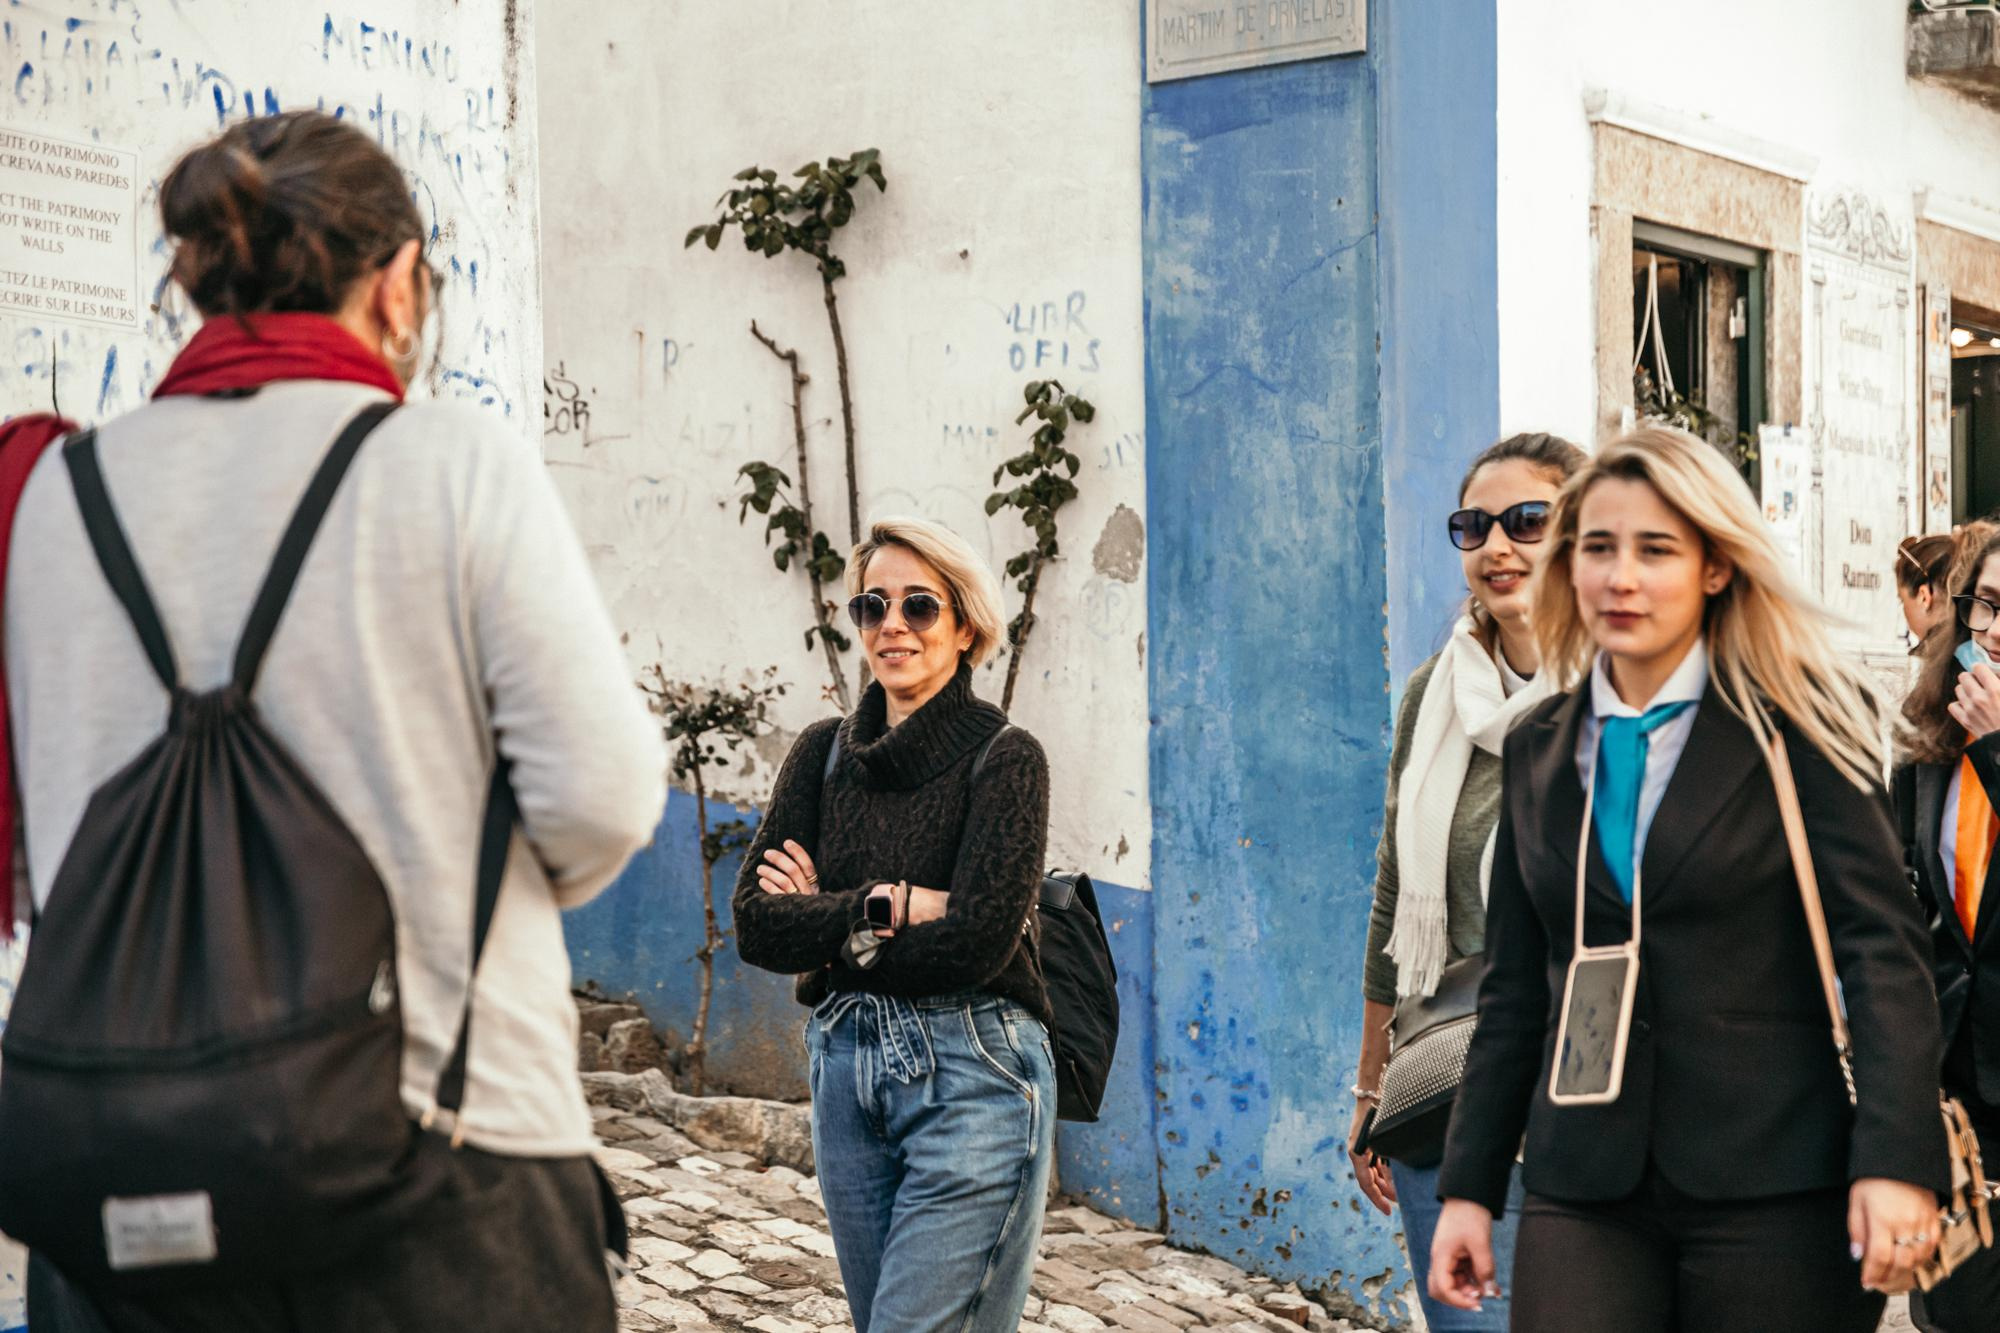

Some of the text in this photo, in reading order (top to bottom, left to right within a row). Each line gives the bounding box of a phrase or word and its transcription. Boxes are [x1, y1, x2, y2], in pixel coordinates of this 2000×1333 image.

[1163, 0, 1345, 46] MARTIM DE ORNELAS
[29, 140, 40, 154] O
[46, 162, 72, 180] NAS
[75, 167, 129, 190] PAREDES
[19, 195, 44, 213] THE
[48, 201, 121, 226] PATRIMONY
[0, 211, 113, 244] OT WRITE ON THE
[21, 234, 65, 255] WALLS
[32, 274, 48, 290] LE
[51, 277, 128, 301] PATRIMOINE
[46, 296, 71, 313] SUR
[74, 301, 97, 316] LES
[100, 304, 136, 322] MURS
[1850, 518, 1873, 545] Don
